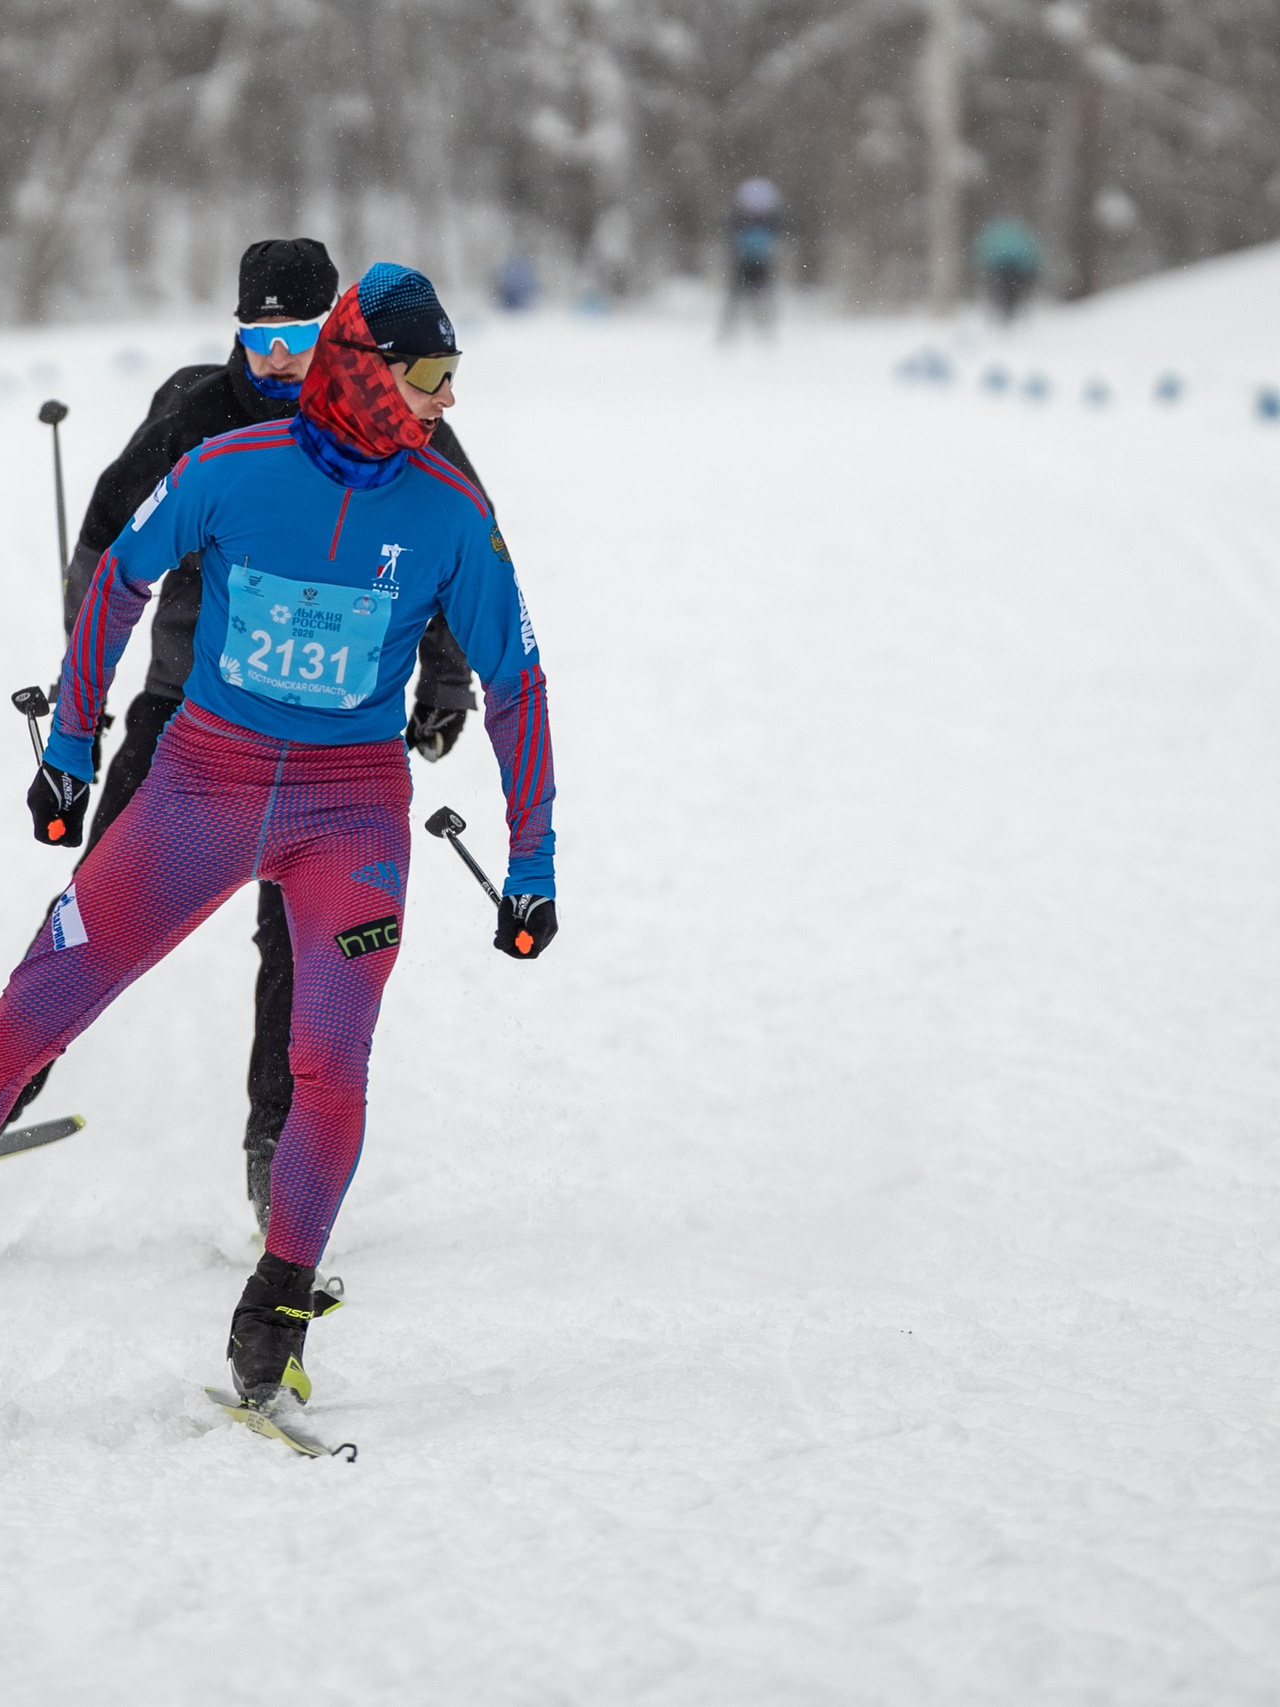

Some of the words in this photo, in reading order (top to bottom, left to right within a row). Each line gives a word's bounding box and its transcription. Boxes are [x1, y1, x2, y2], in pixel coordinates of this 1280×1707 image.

[292, 616, 341, 632] РОССИИ
[293, 607, 343, 623] ЛЫЖНЯ
[247, 629, 349, 684] 2131
[247, 669, 308, 692] КОСТРОМСКАЯ
[308, 683, 347, 696] ОБЛАСТЬ
